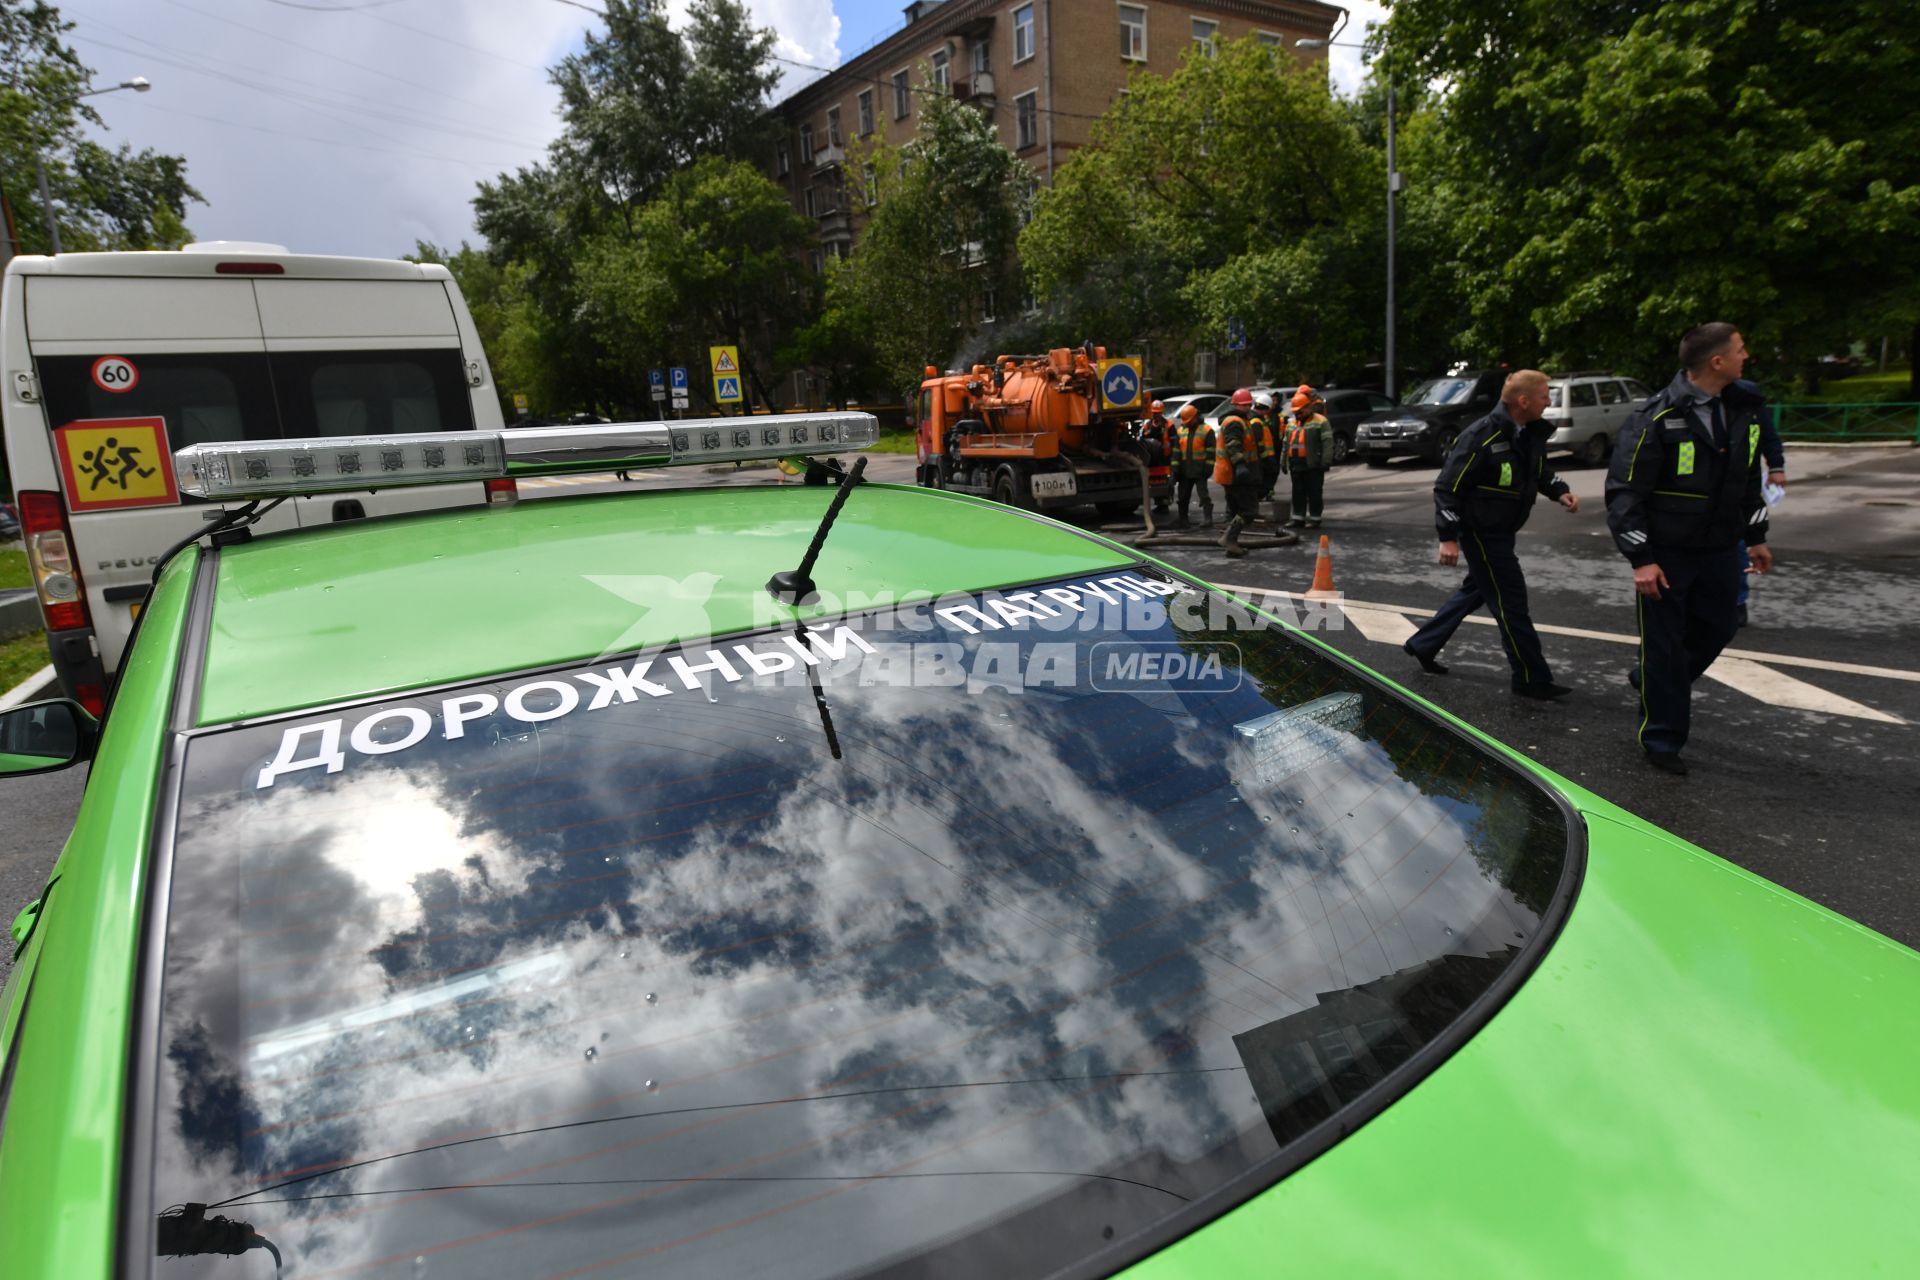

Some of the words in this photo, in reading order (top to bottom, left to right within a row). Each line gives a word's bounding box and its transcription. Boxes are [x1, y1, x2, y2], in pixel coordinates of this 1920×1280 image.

[102, 365, 130, 384] 60
[674, 370, 684, 386] P
[98, 556, 159, 570] PEUG
[256, 622, 878, 789] ДОРОЖНЫЙ
[934, 573, 1175, 635] ПАТРУЛЬ
